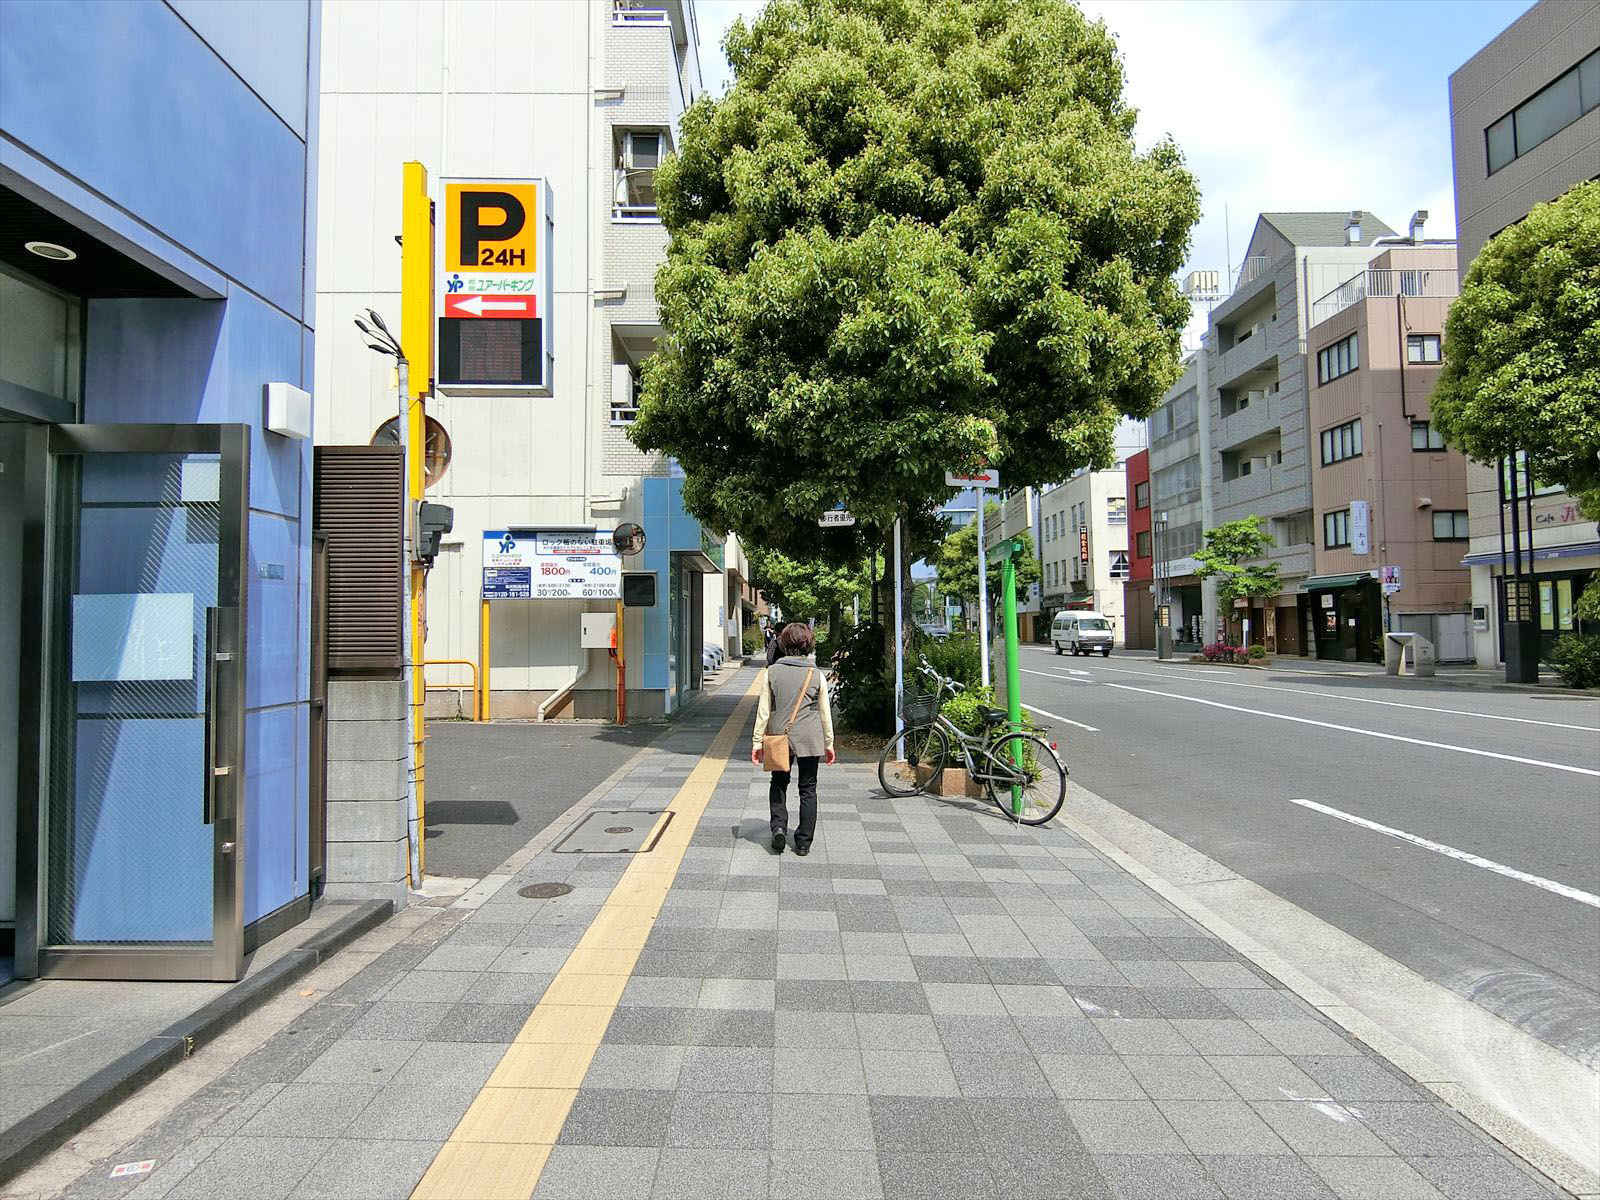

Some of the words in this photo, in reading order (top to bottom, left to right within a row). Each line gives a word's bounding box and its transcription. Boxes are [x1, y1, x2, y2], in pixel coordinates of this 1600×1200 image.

[460, 191, 526, 266] P
[481, 248, 525, 266] 24H
[542, 538, 613, 546] ロック板のない駐車場
[540, 567, 571, 576] 1800円
[590, 567, 617, 576] 400円
